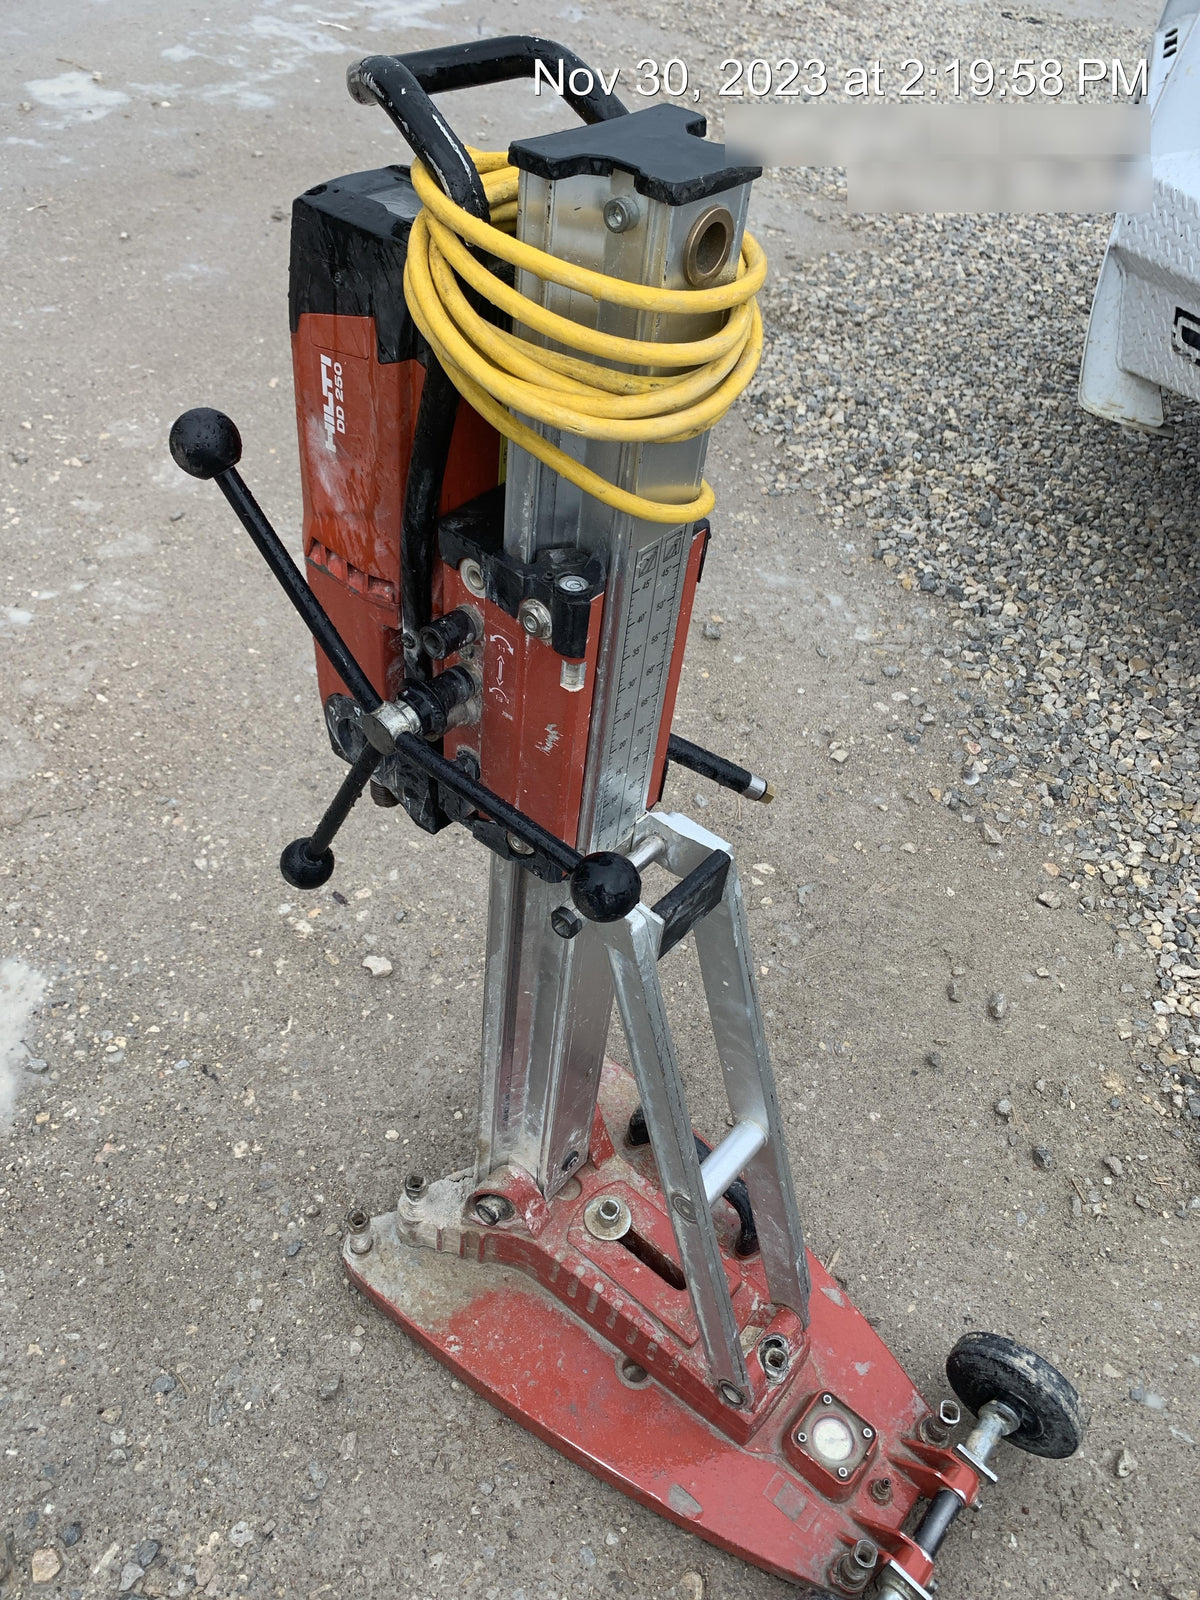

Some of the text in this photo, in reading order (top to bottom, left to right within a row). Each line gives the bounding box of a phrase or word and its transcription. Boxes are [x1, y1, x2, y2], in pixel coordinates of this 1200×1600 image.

[320, 353, 337, 453] HILTI
[333, 361, 346, 435] DD 250
